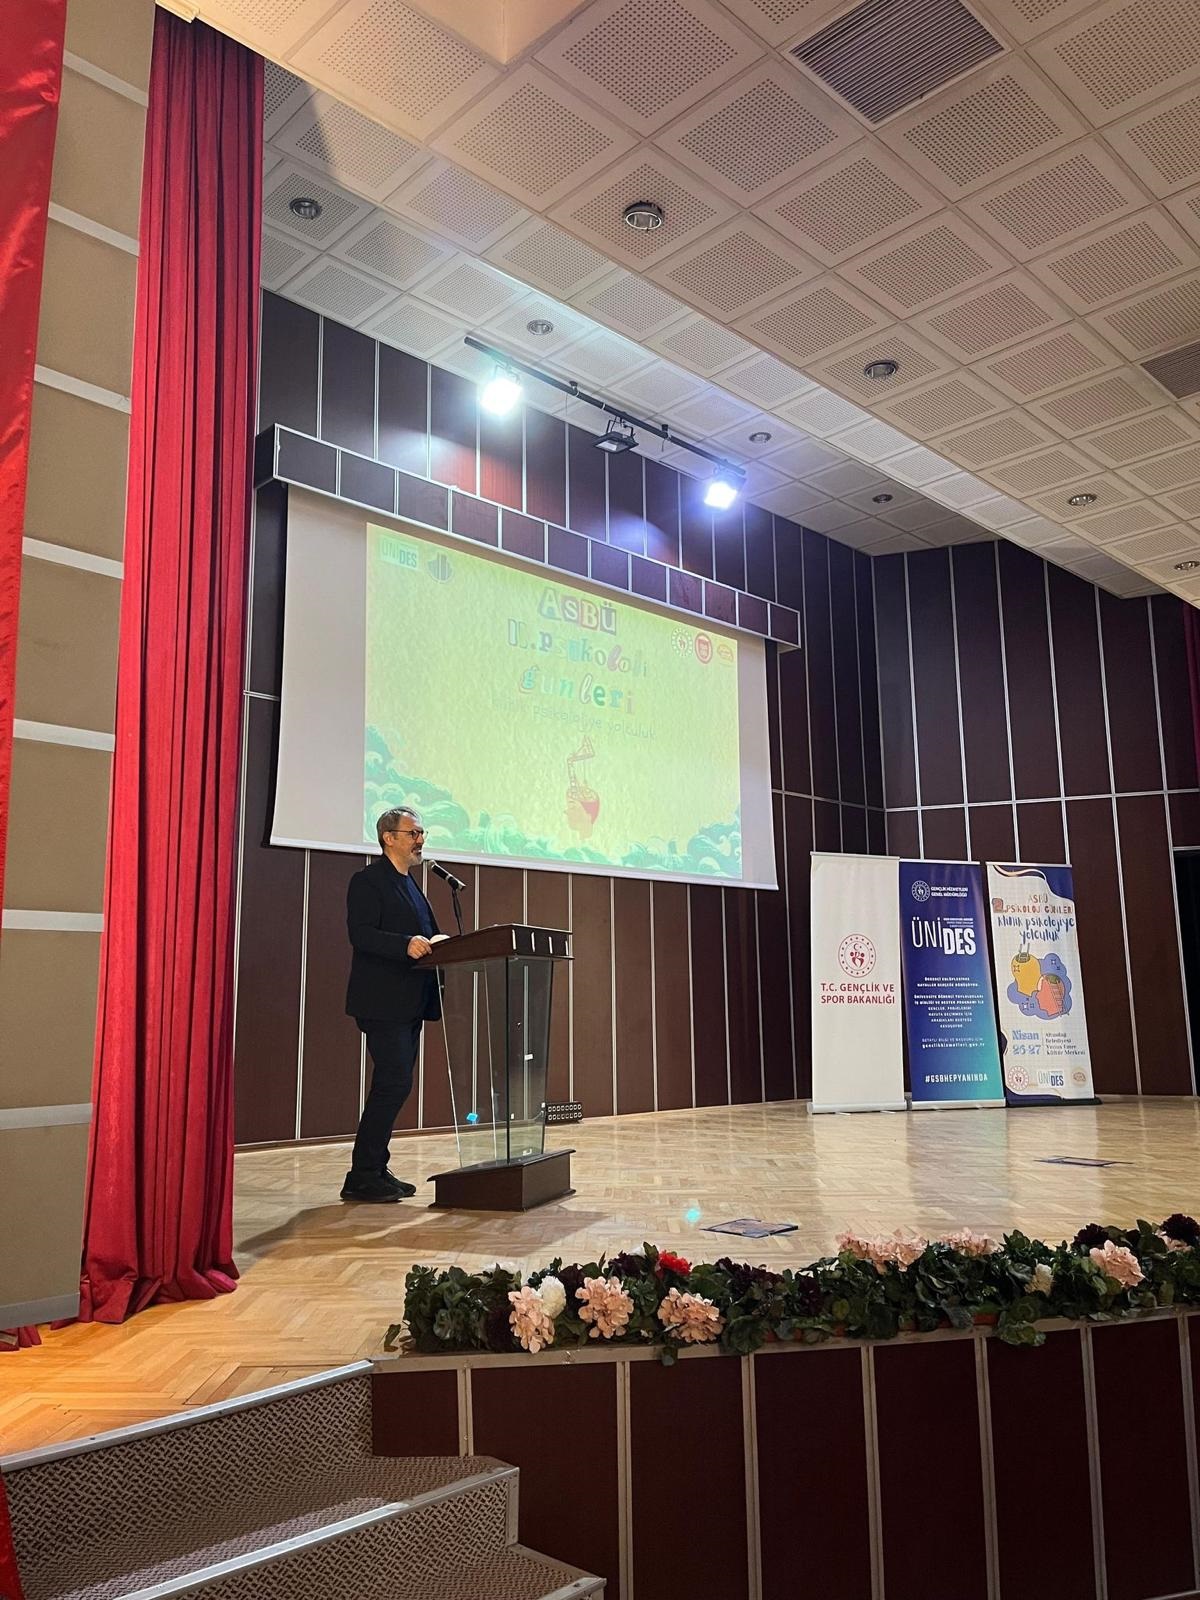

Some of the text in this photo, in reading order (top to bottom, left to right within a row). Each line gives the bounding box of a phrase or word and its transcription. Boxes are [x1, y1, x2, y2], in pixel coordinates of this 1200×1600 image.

[820, 982, 895, 994] T.C. GENÇLİK VE
[821, 994, 895, 1004] SPOR BAKANLIĞI
[1012, 1029, 1039, 1040] Nisan
